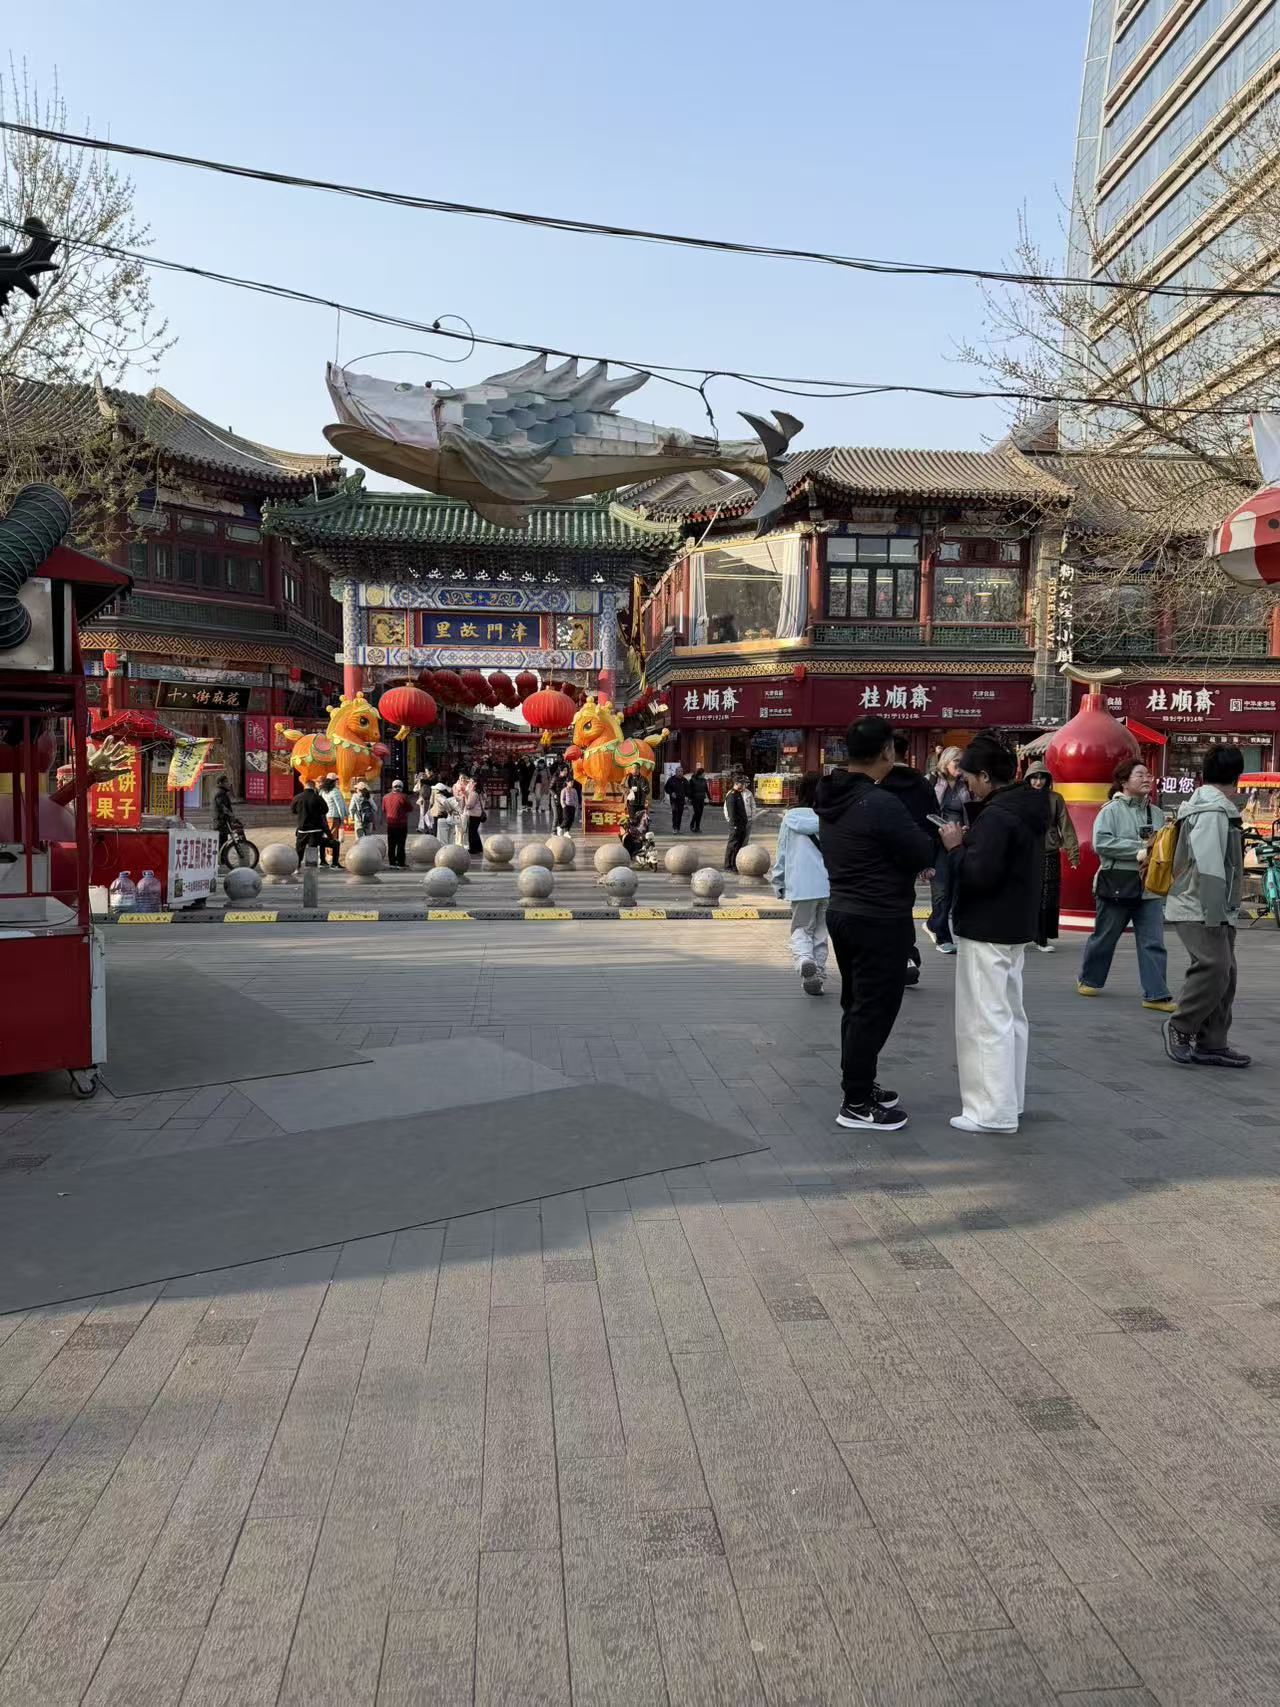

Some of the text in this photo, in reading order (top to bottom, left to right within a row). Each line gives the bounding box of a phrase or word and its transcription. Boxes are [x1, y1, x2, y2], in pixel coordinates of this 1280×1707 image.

[167, 688, 241, 706] 十八街麻花
[1156, 777, 1195, 793] 迎您
[97, 797, 136, 819] 果子
